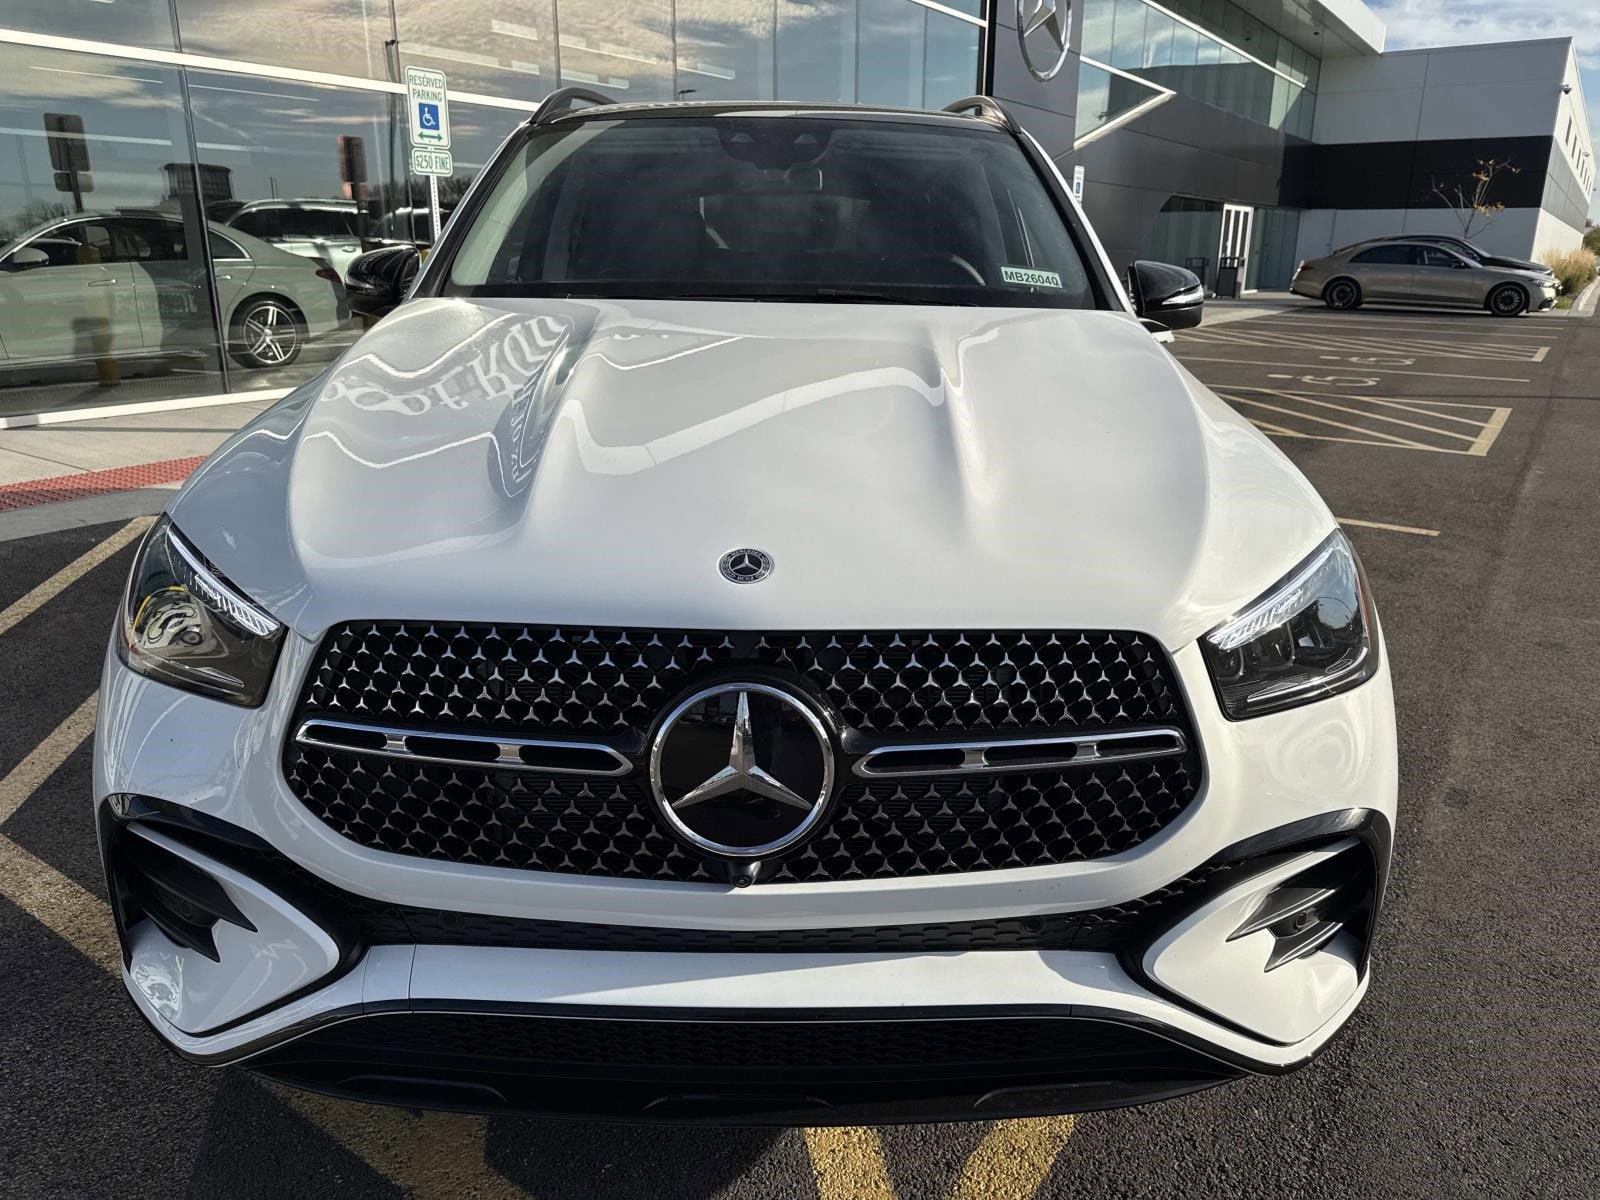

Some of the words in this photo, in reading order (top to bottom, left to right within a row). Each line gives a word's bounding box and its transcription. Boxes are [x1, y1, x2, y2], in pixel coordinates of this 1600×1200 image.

[409, 74, 443, 89] RESERVED
[412, 89, 442, 102] PARKING
[415, 154, 433, 169] $250
[434, 156, 449, 171] FINE
[1004, 270, 1059, 286] MB26040
